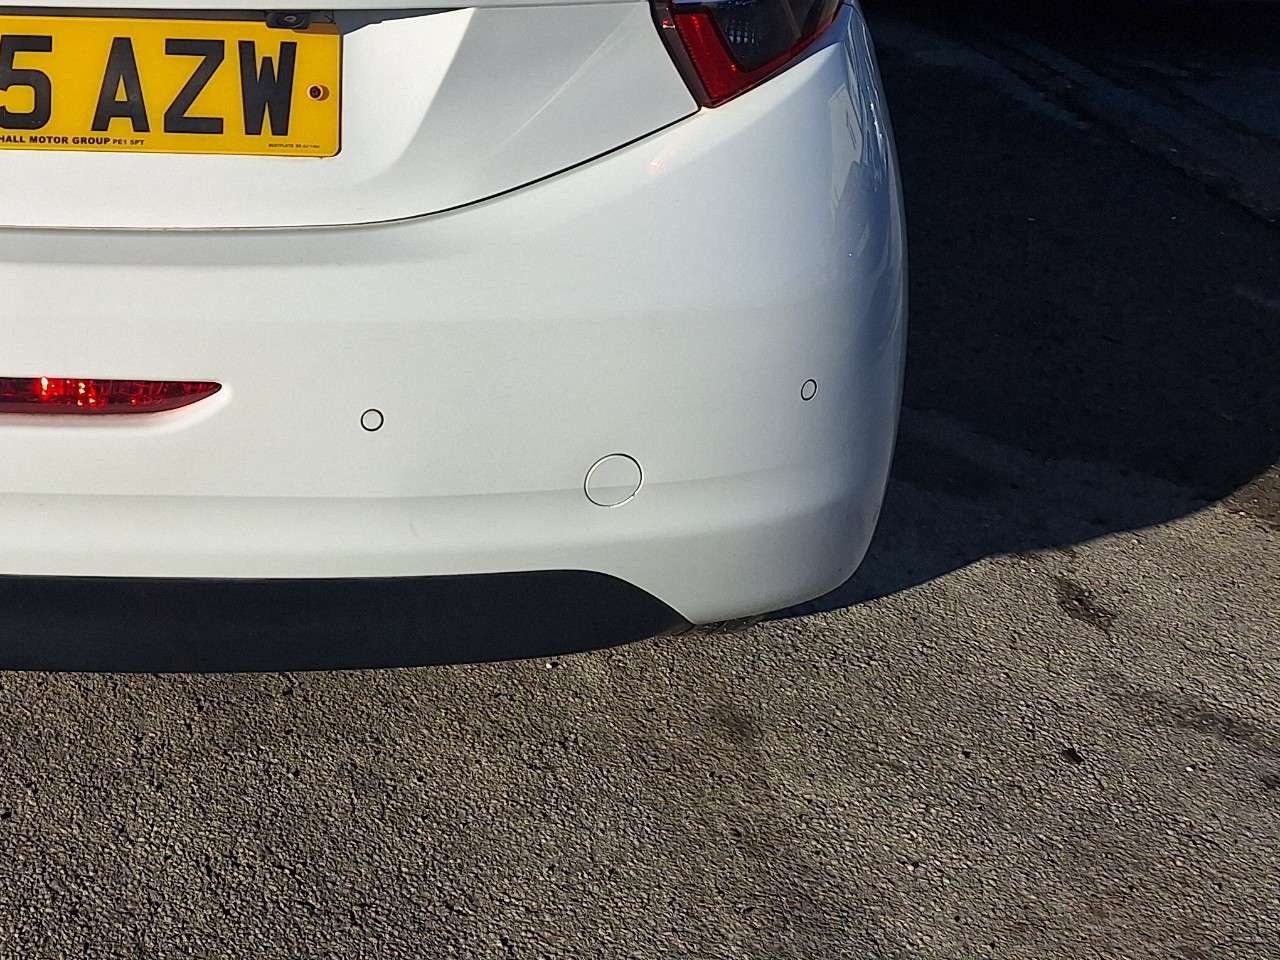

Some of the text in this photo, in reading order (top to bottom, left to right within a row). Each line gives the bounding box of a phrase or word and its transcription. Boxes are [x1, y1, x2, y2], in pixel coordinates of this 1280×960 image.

[90, 35, 299, 138] AZW
[29, 135, 69, 145] MOTOR
[72, 136, 111, 145] GROUP
